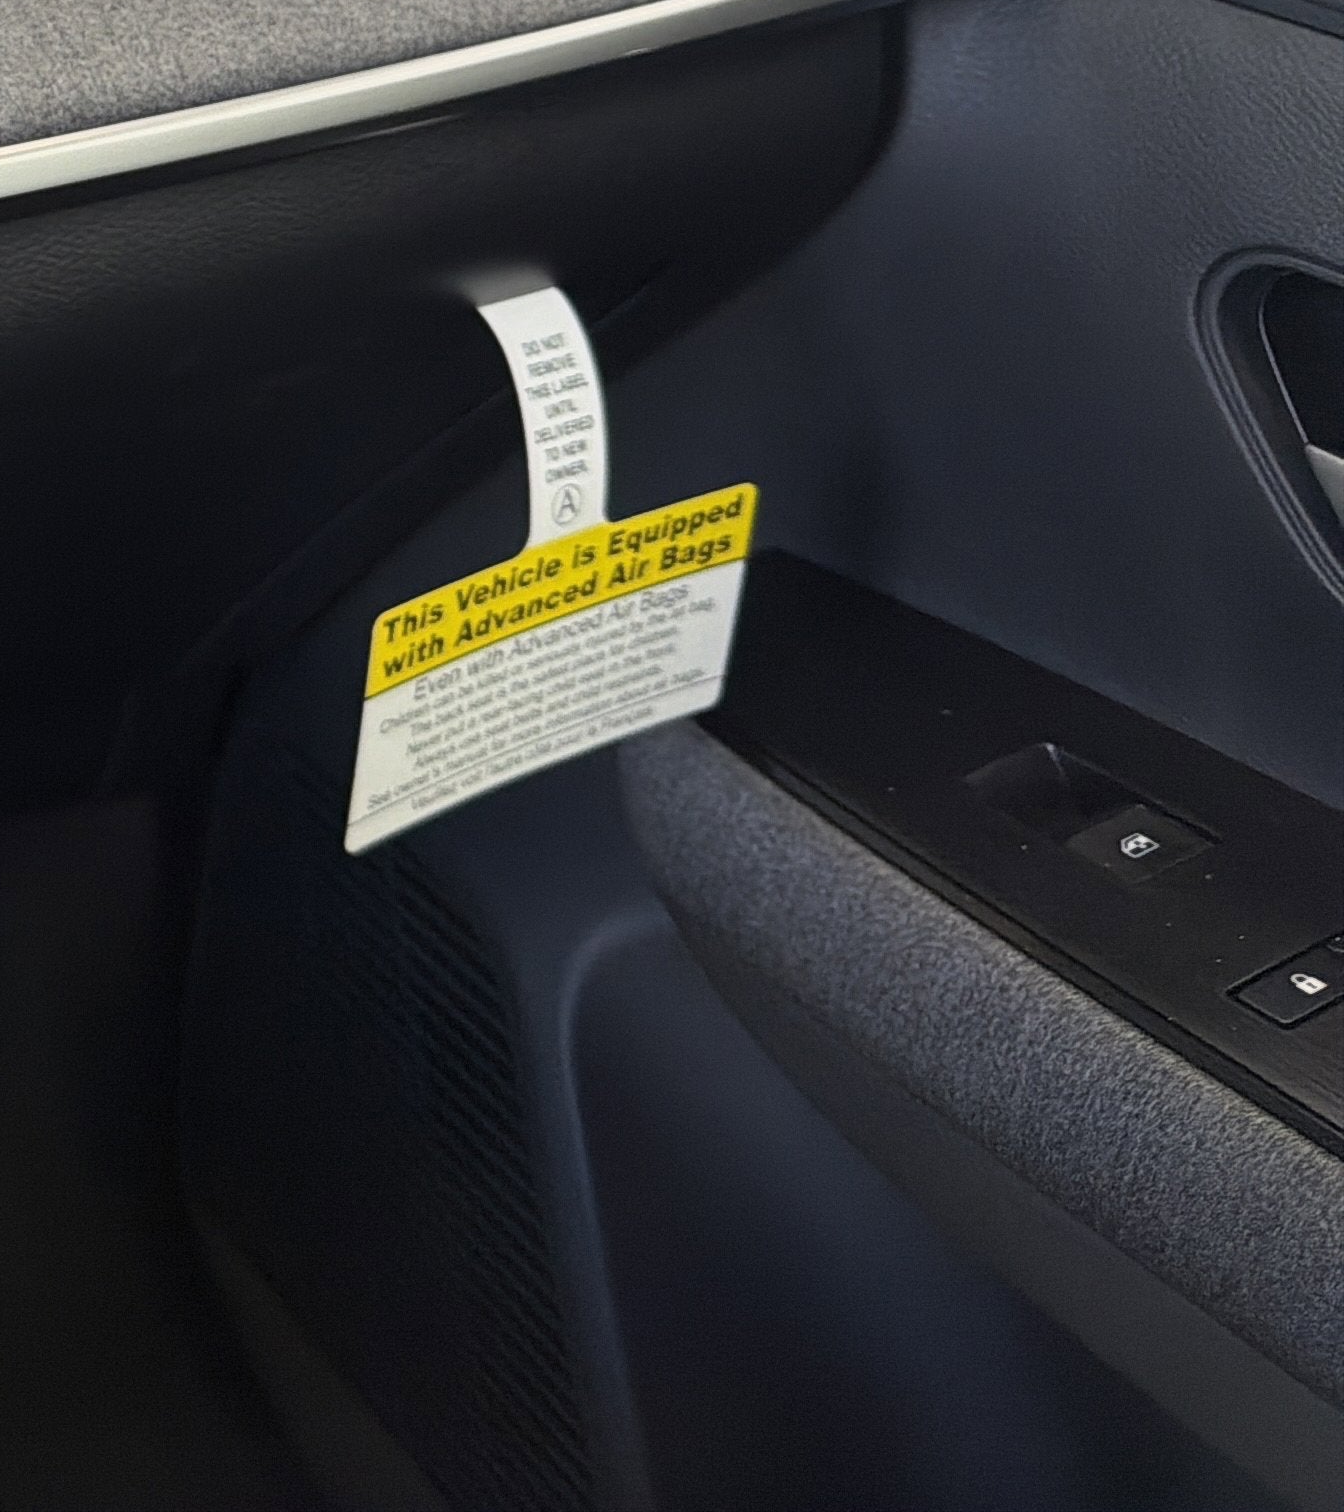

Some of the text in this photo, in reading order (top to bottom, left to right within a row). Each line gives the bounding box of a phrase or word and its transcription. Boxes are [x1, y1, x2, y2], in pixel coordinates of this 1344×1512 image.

[527, 353, 576, 376] REMOVE
[525, 373, 589, 400] THIS LABEL
[544, 398, 577, 419] UNTIL
[534, 414, 594, 444] DELIVERED
[383, 492, 744, 643] This Vehicle is Equipped
[383, 534, 733, 677] with Advanced Air Bags
[414, 584, 689, 700] Even with Advanced Air Bags
